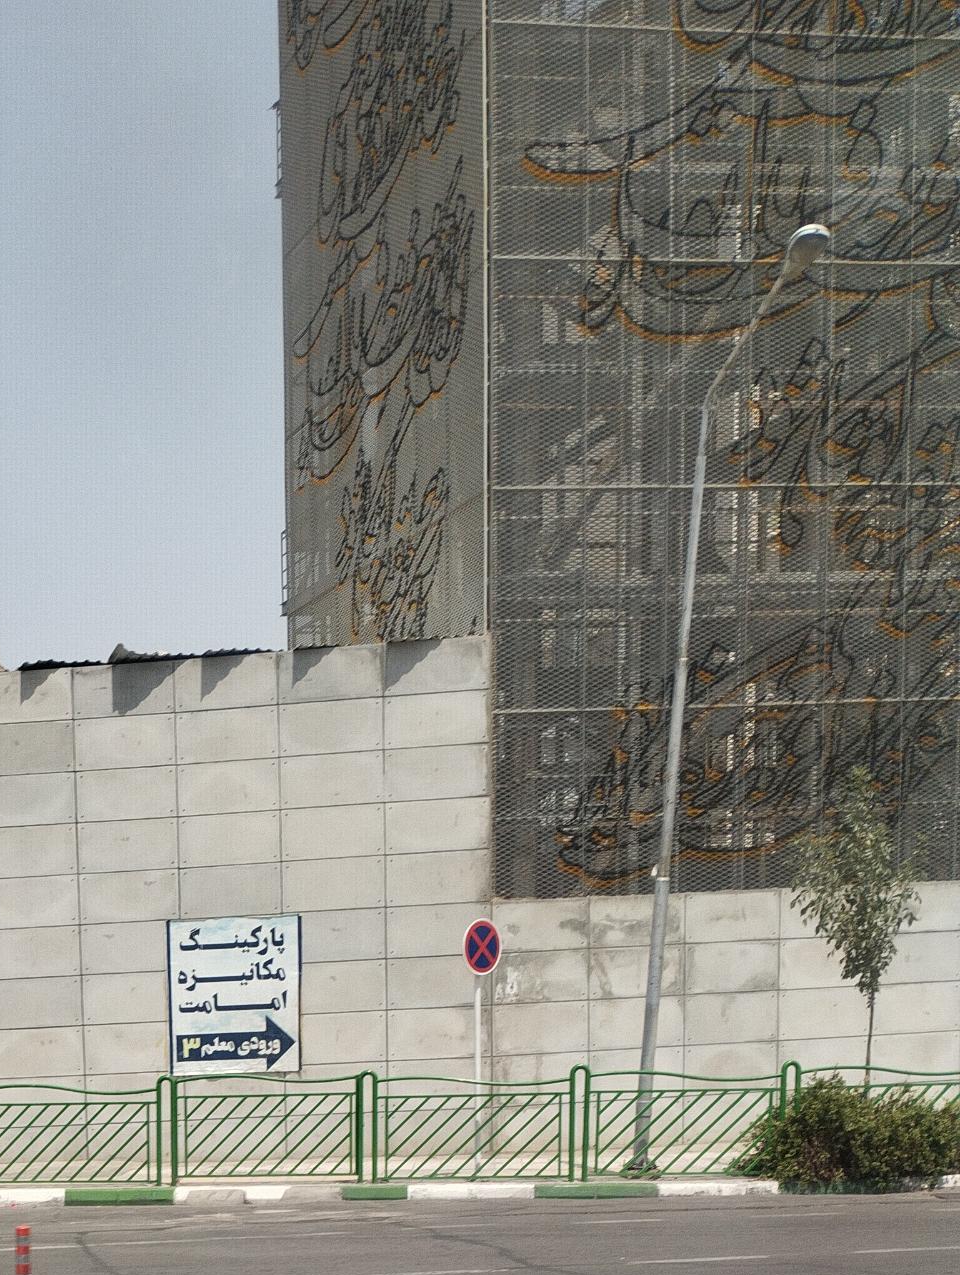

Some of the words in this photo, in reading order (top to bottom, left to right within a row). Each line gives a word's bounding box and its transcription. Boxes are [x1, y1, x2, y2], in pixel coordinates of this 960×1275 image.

[179, 925, 285, 955] پارکینگ
[178, 958, 286, 991] مکانیزه
[179, 990, 288, 1013] امامت
[182, 1037, 201, 1059] ۳
[200, 1037, 235, 1057] معلم
[237, 1036, 281, 1057] ورودی
